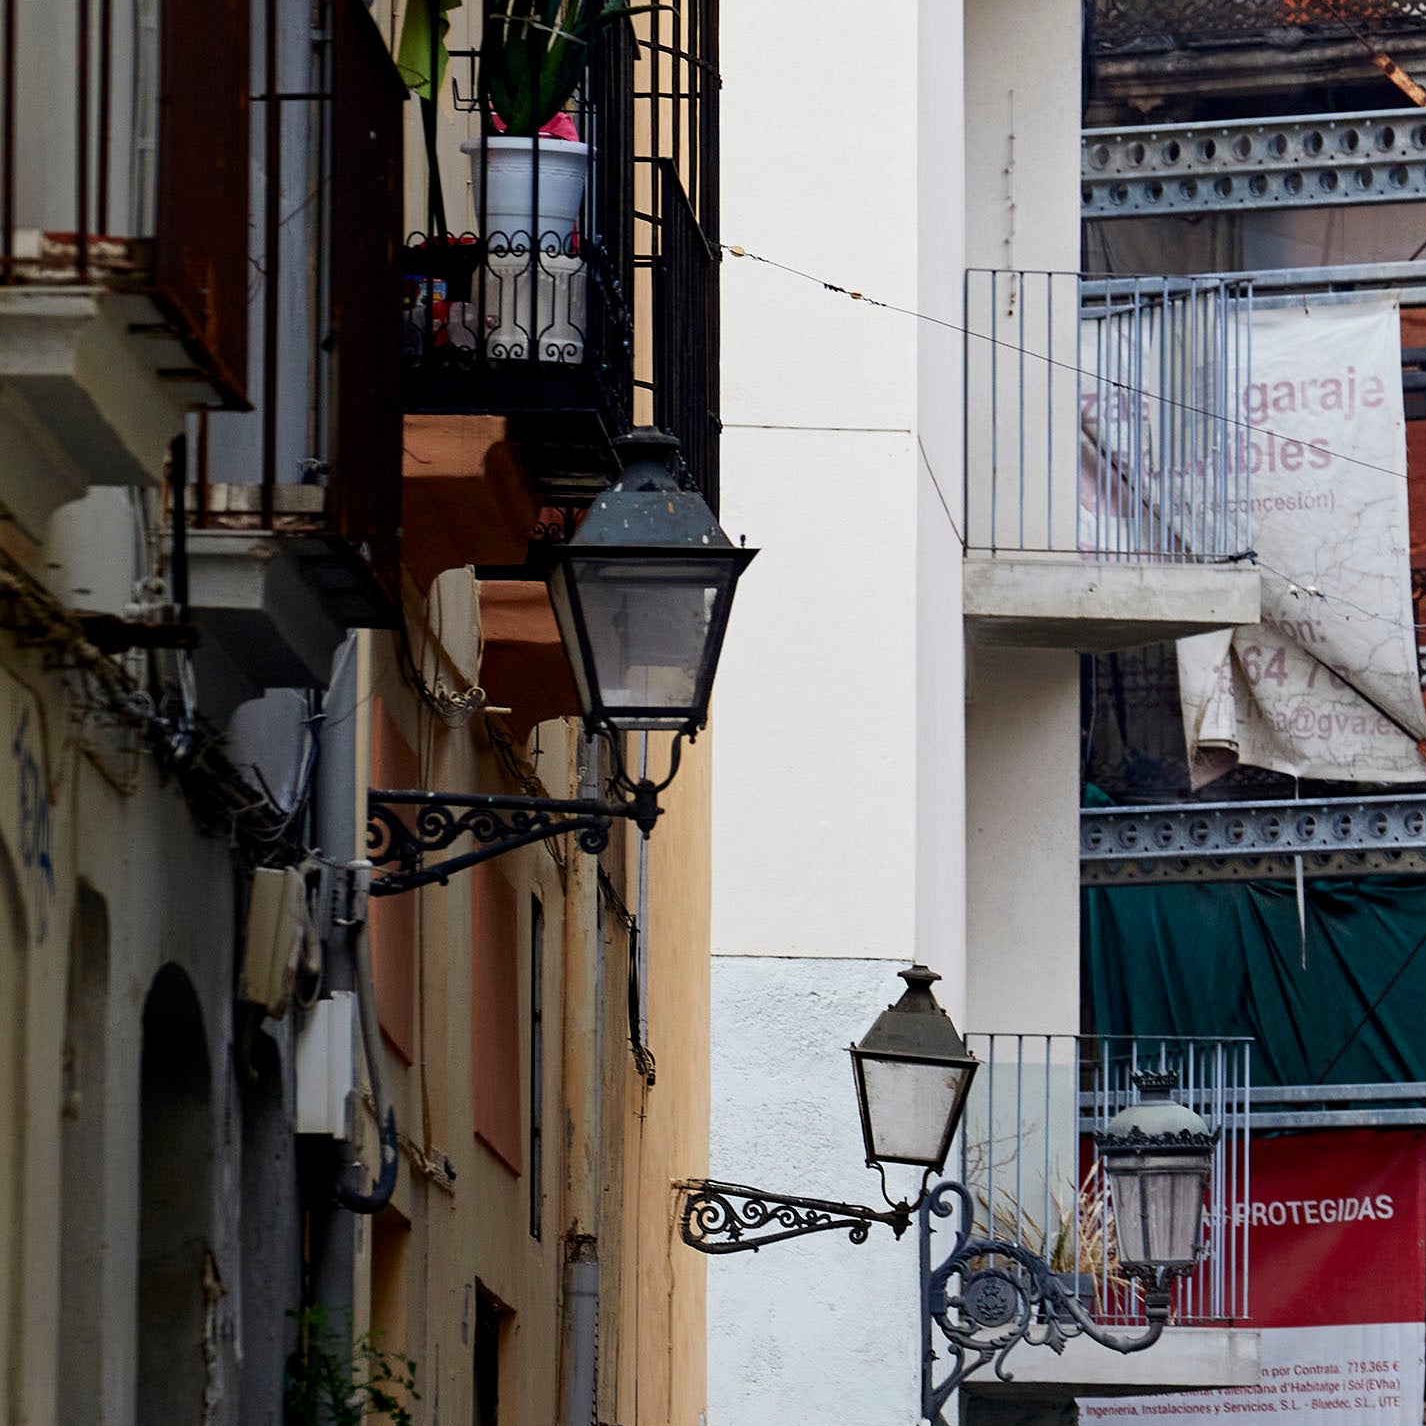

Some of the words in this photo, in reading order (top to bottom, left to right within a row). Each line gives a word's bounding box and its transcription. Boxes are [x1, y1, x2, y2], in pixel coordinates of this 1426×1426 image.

[1243, 366, 1385, 423] garaje
[1235, 1194, 1394, 1228] PROTEGIDAS
[1272, 1365, 1290, 1379] por
[1294, 1363, 1342, 1376] Contrata:
[1347, 1360, 1390, 1374] 719.365
[1393, 1360, 1400, 1372] €
[1142, 1404, 1211, 1416] Instalaciones
[1223, 1400, 1277, 1414] Servicios,
[1379, 1395, 1401, 1408] UTE
